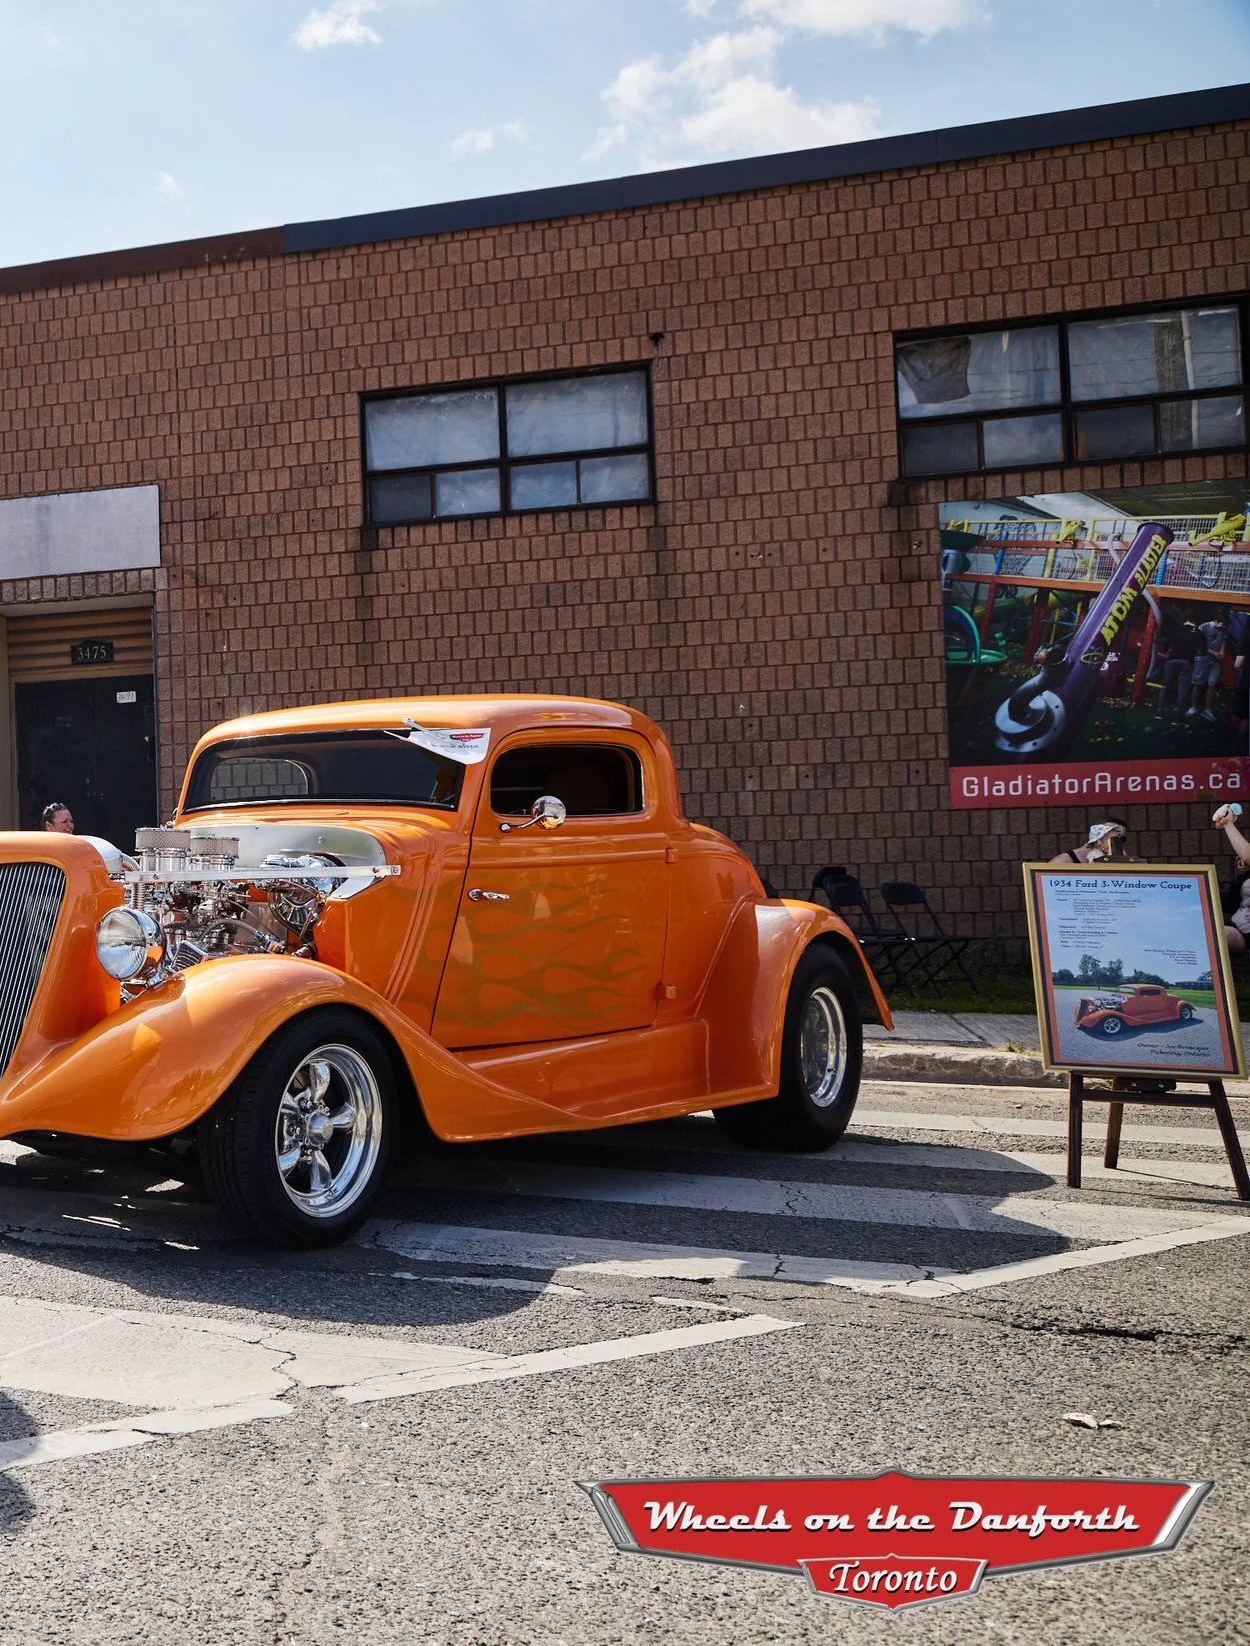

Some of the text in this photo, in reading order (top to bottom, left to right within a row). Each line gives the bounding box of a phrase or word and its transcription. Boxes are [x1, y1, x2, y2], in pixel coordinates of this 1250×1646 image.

[1101, 587, 1138, 646] ATOM
[77, 645, 107, 661] 3475
[962, 773, 1241, 798] GladiatorArenas.ca
[1049, 879, 1071, 888] 1934
[1075, 880, 1098, 888] Ford
[1160, 881, 1192, 891] Coupe
